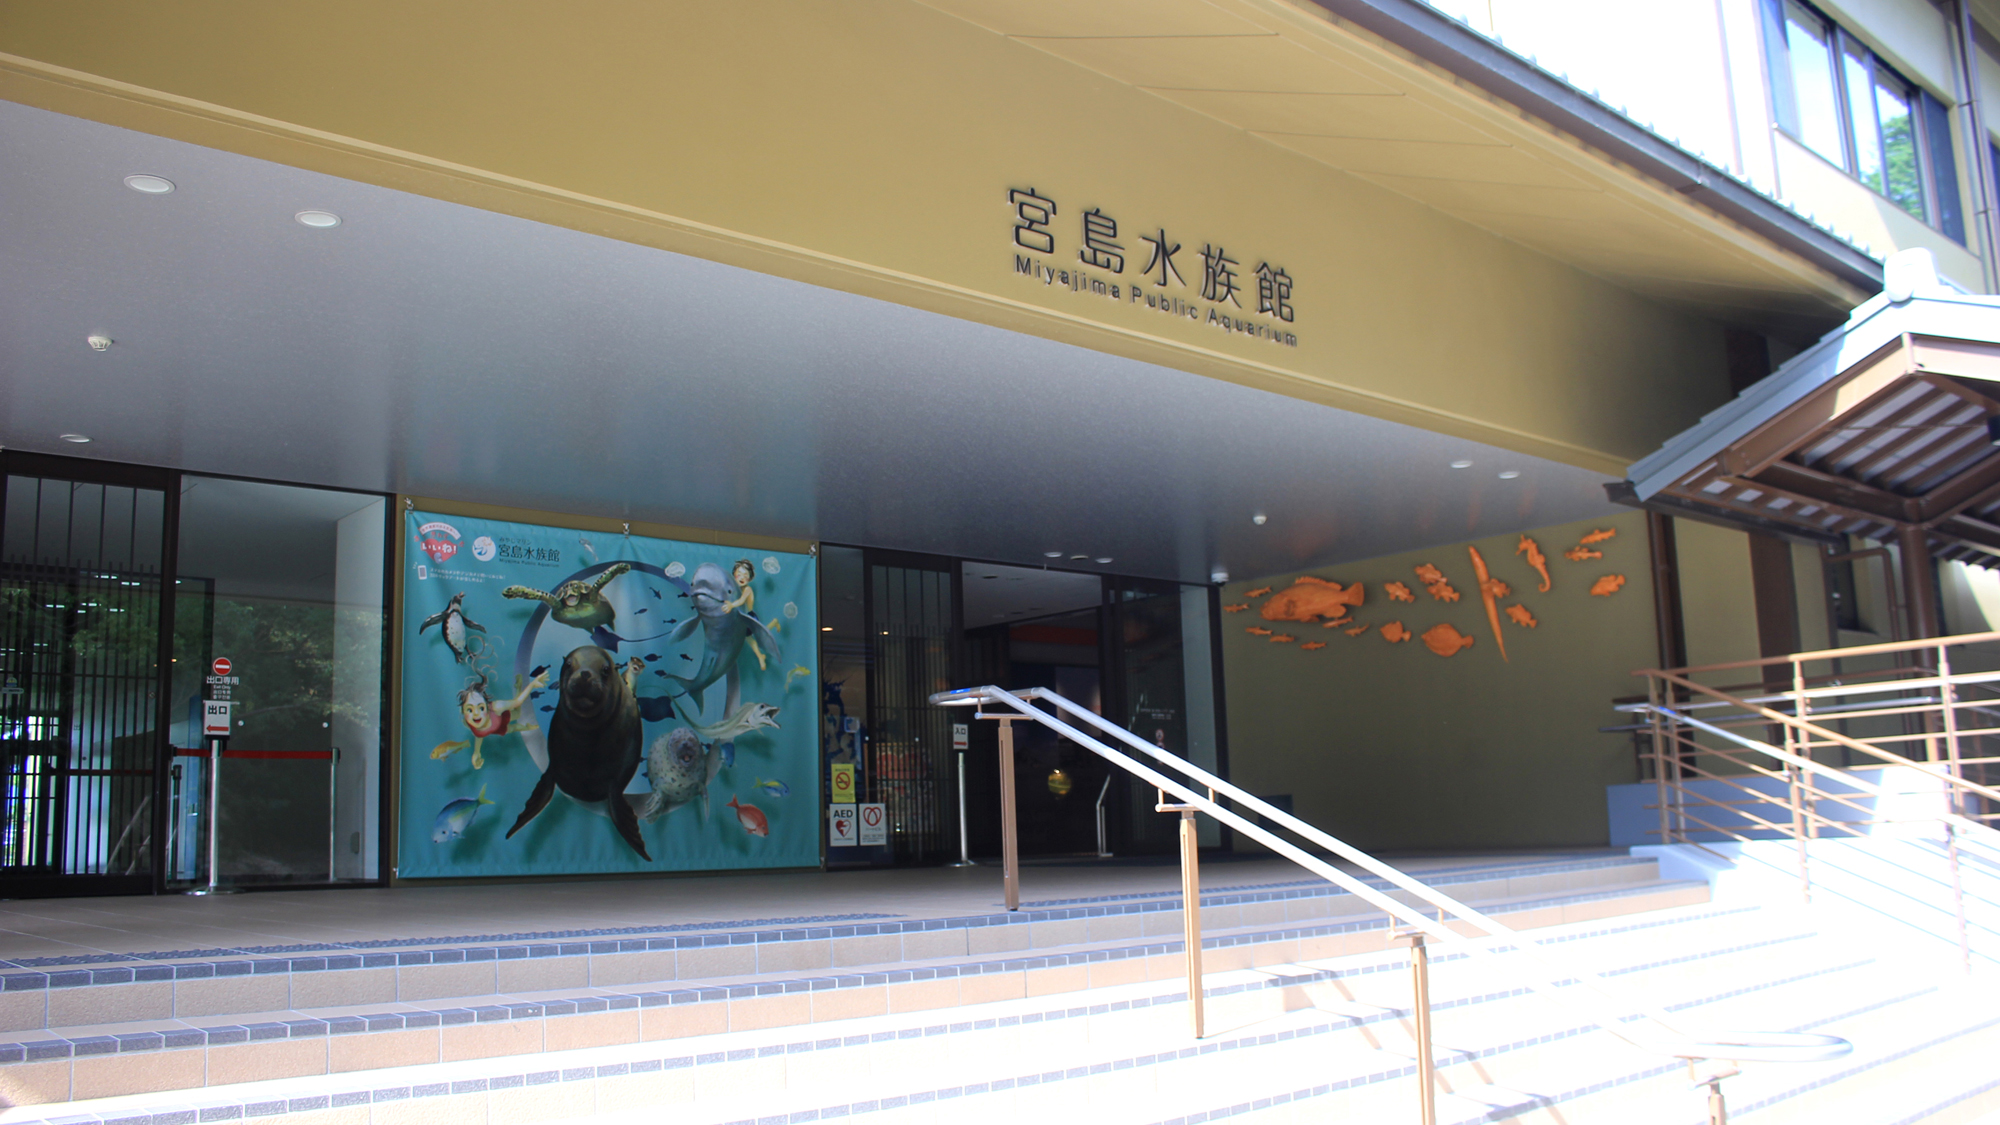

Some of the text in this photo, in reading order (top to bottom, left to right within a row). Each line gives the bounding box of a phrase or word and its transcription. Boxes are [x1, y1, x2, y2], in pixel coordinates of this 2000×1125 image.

[1007, 187, 1294, 322] 宮島水族館
[1013, 254, 1297, 347] Miyajima Public Aquarium
[499, 544, 560, 562] 宮島水族館
[206, 676, 239, 685] 出口専用
[208, 705, 227, 715] 出口
[954, 727, 967, 735] 入口
[833, 809, 854, 818] AED
